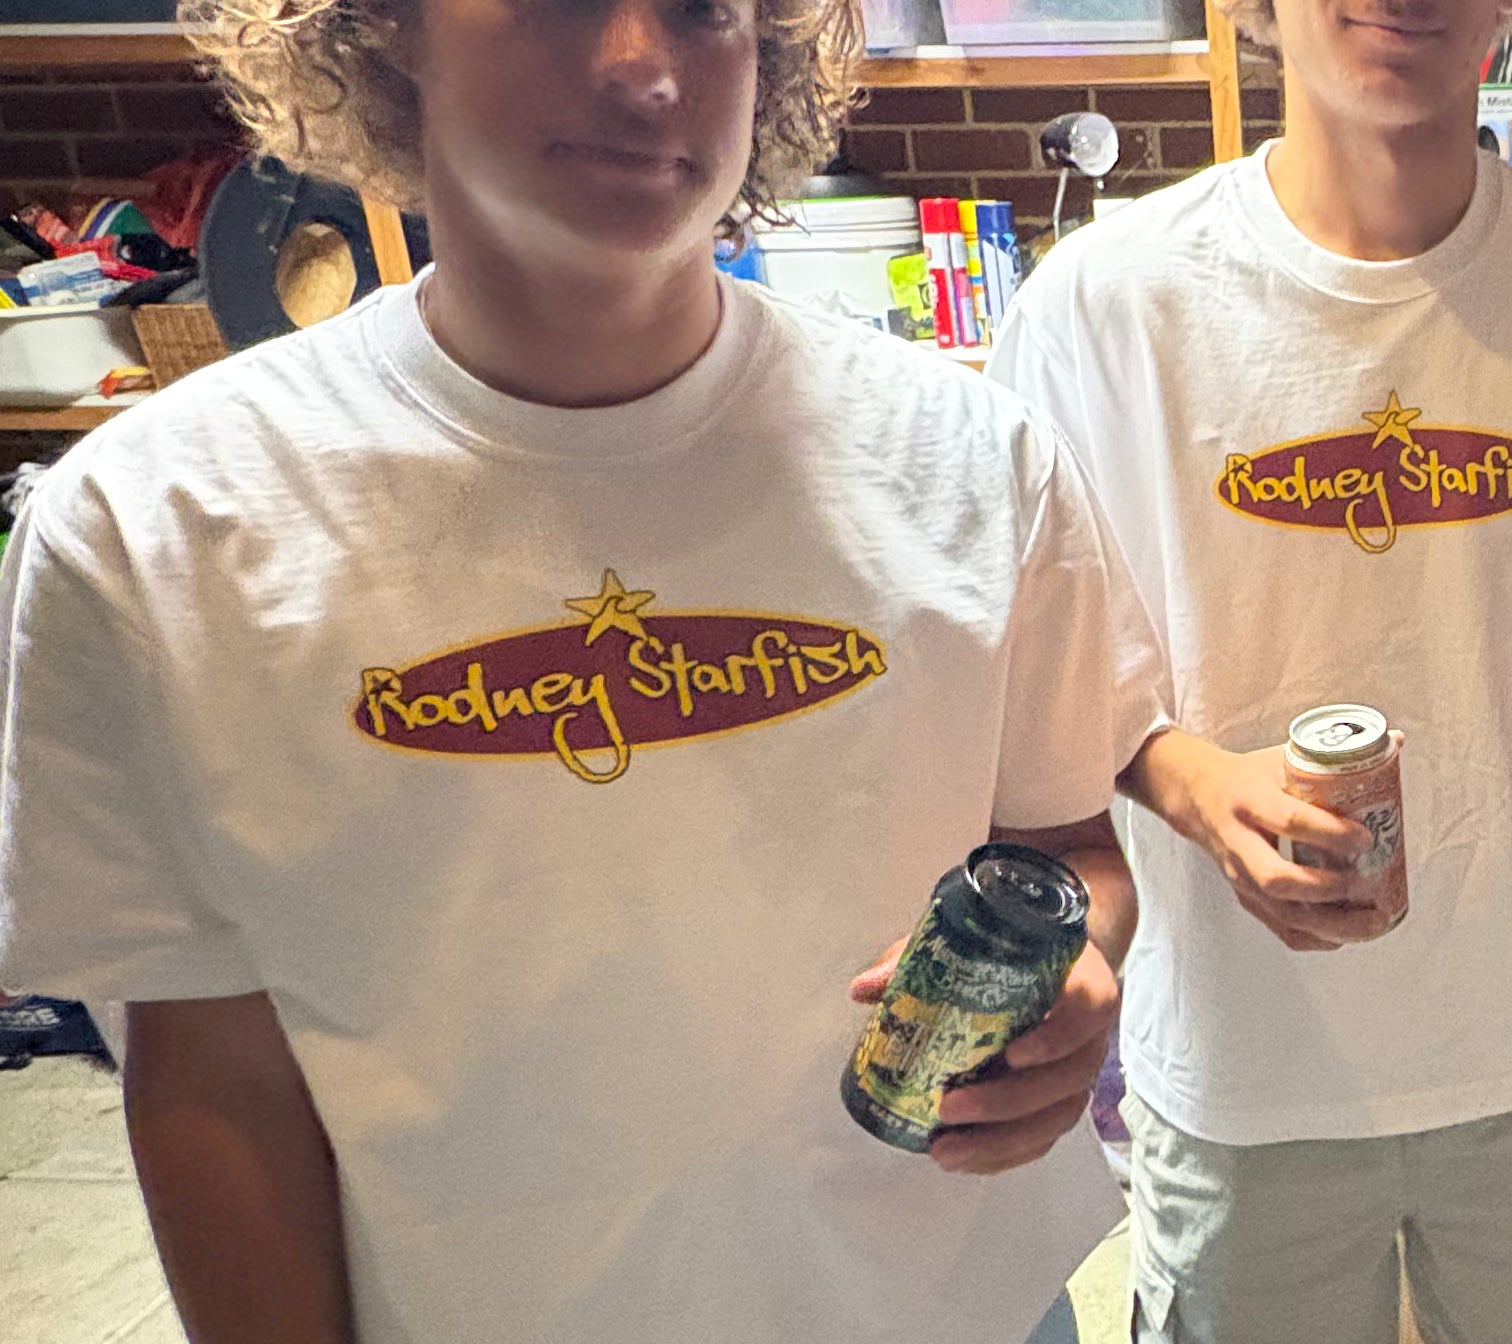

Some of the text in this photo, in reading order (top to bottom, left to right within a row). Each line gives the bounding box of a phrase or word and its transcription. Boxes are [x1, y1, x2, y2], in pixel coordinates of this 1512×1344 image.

[1225, 452, 1397, 554] Rodney
[359, 628, 888, 784] Rodney Starfish
